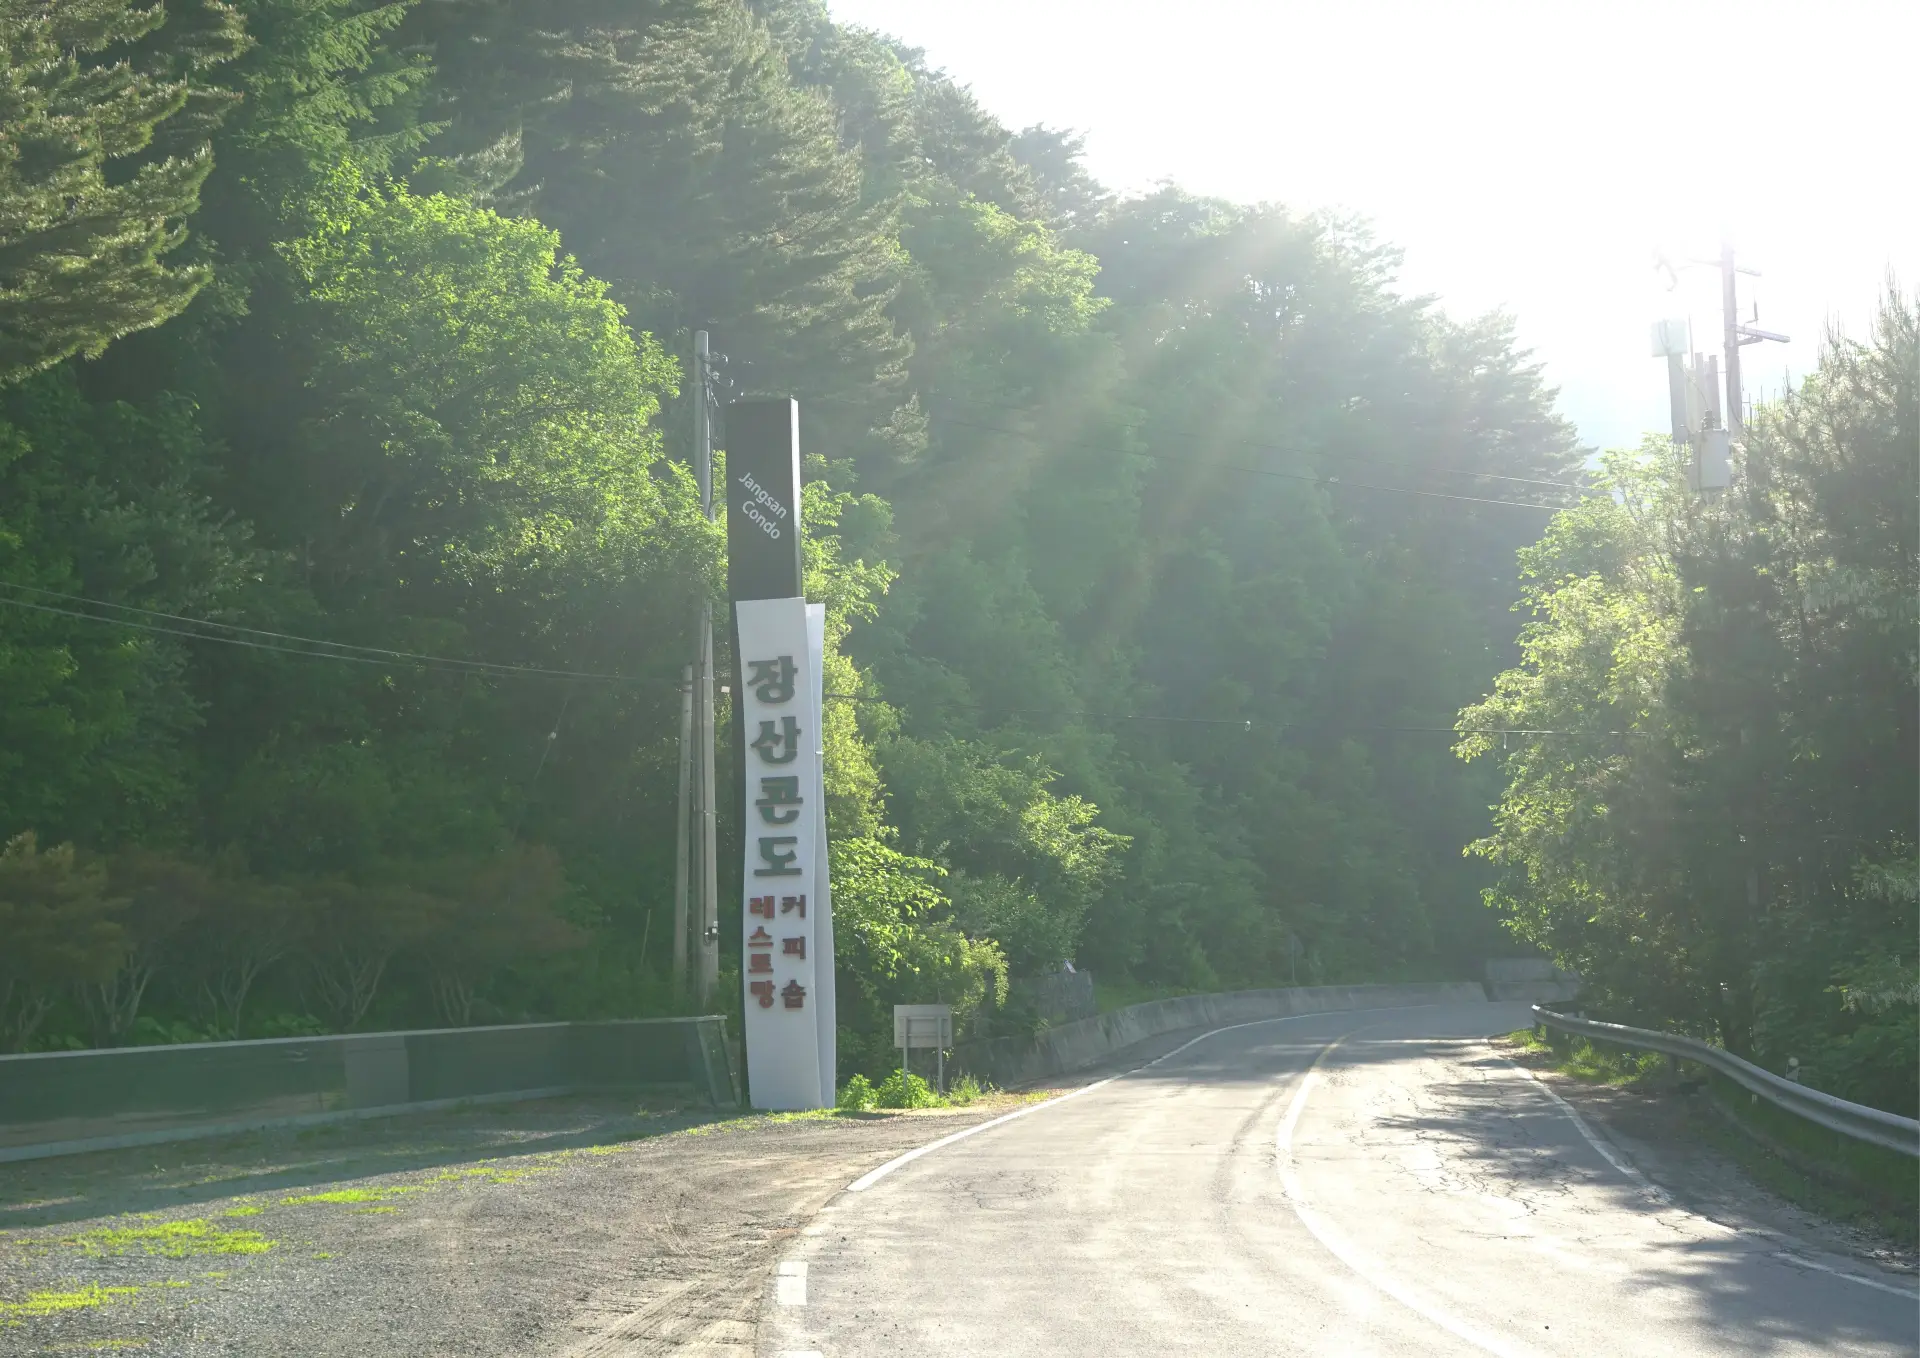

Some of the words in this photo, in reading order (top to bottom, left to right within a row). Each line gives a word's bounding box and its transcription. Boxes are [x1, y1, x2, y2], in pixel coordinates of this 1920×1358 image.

[738, 472, 788, 519] Jangsan
[741, 500, 781, 540] Condo
[747, 655, 804, 877] 장산콘도
[748, 895, 776, 1009] 레스토랑
